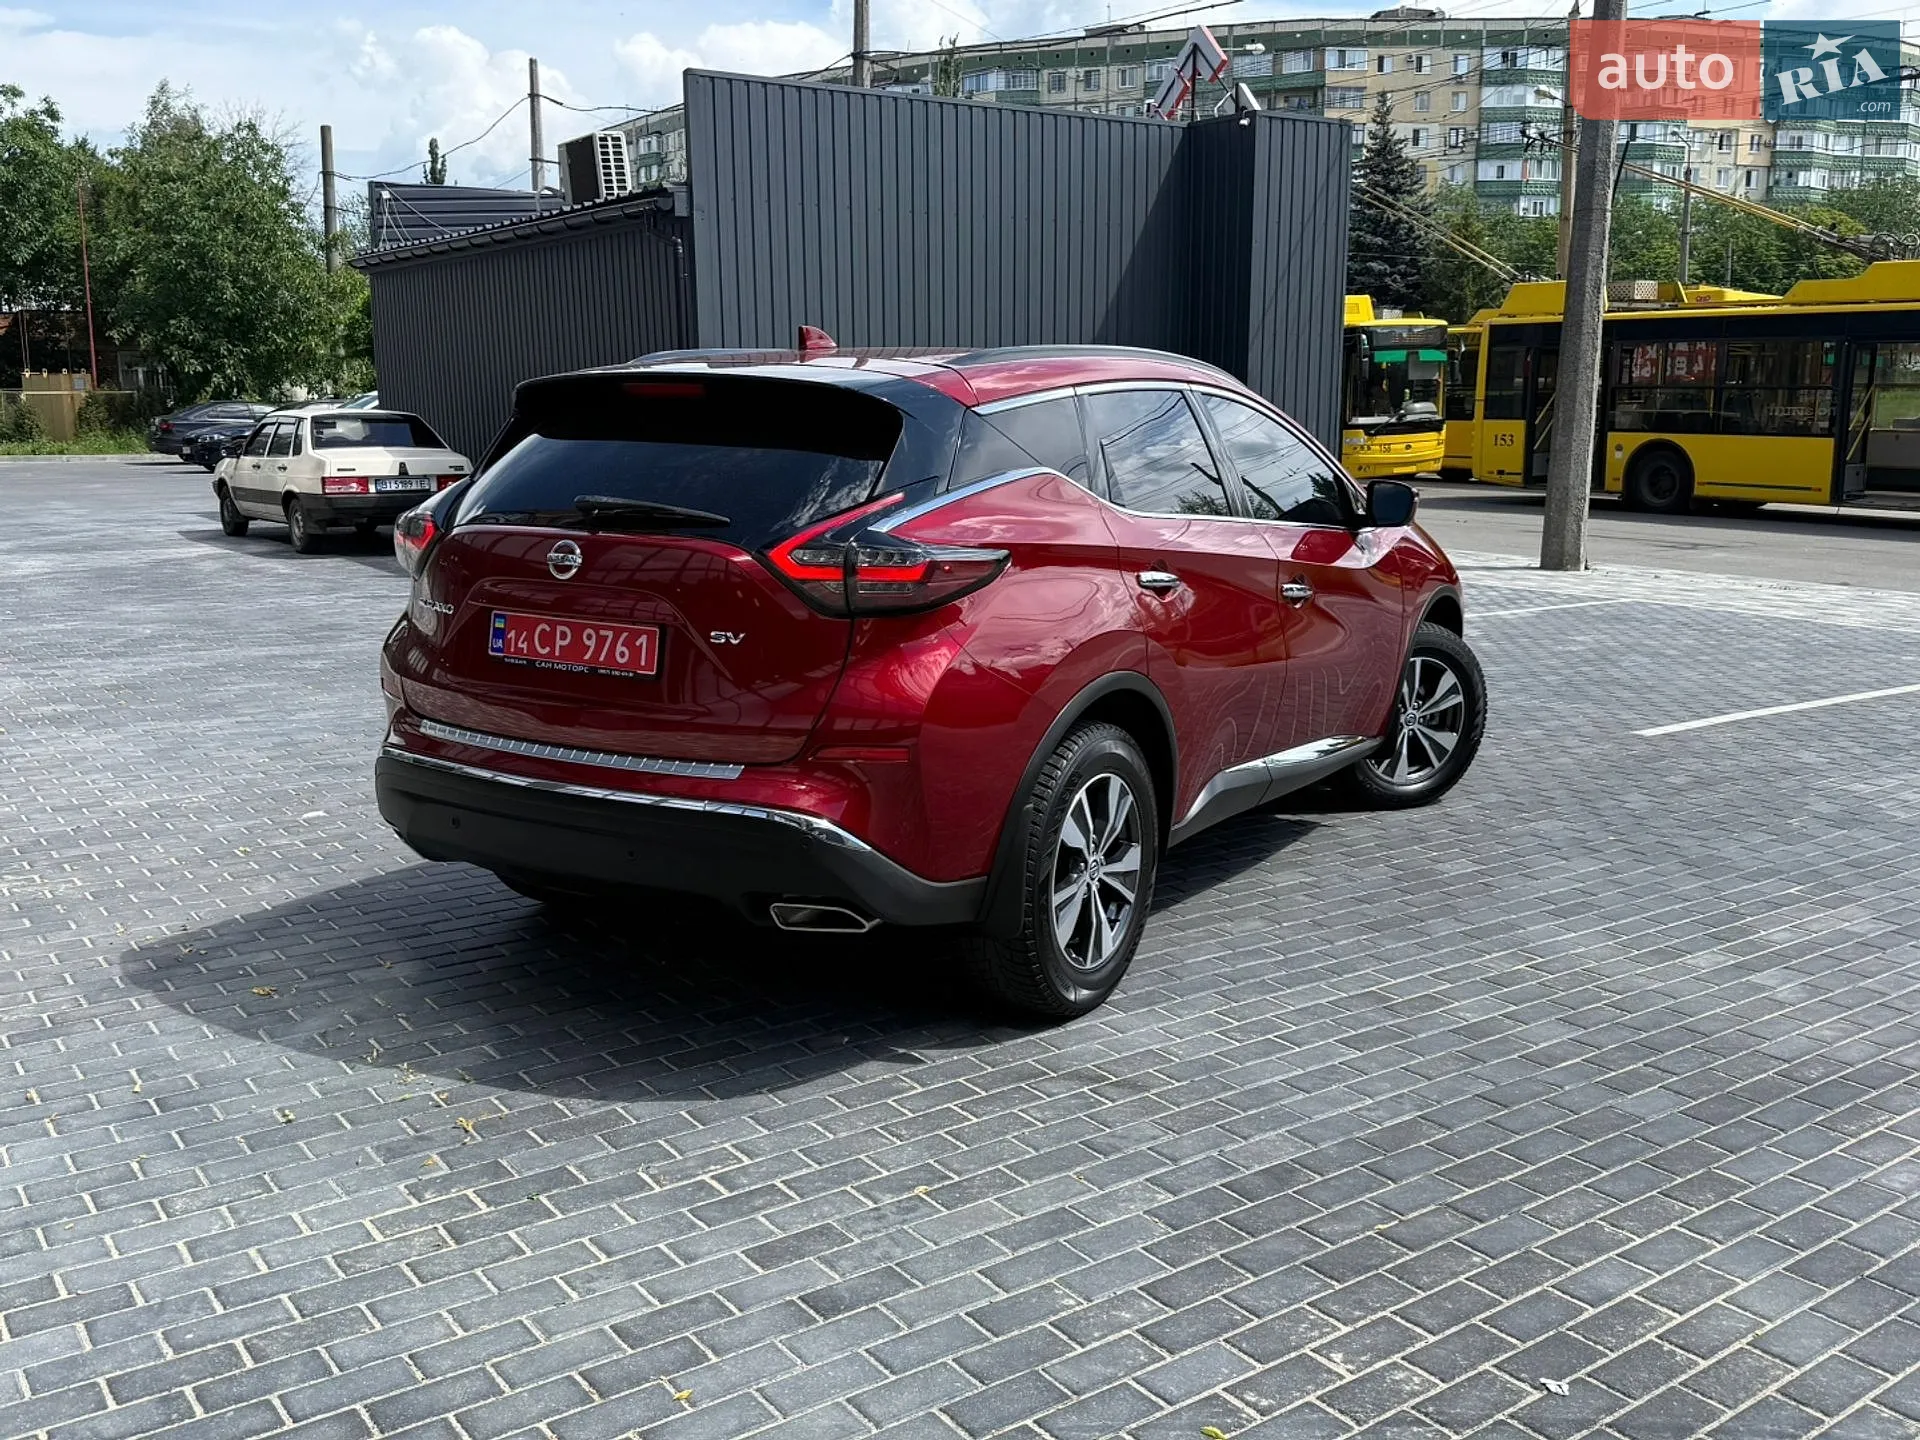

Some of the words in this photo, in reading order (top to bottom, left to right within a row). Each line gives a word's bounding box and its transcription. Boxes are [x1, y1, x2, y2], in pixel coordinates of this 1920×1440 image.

[1494, 433, 1514, 447] 153
[492, 638, 504, 649] UA
[710, 631, 746, 645] SV
[582, 627, 648, 667] 9761
